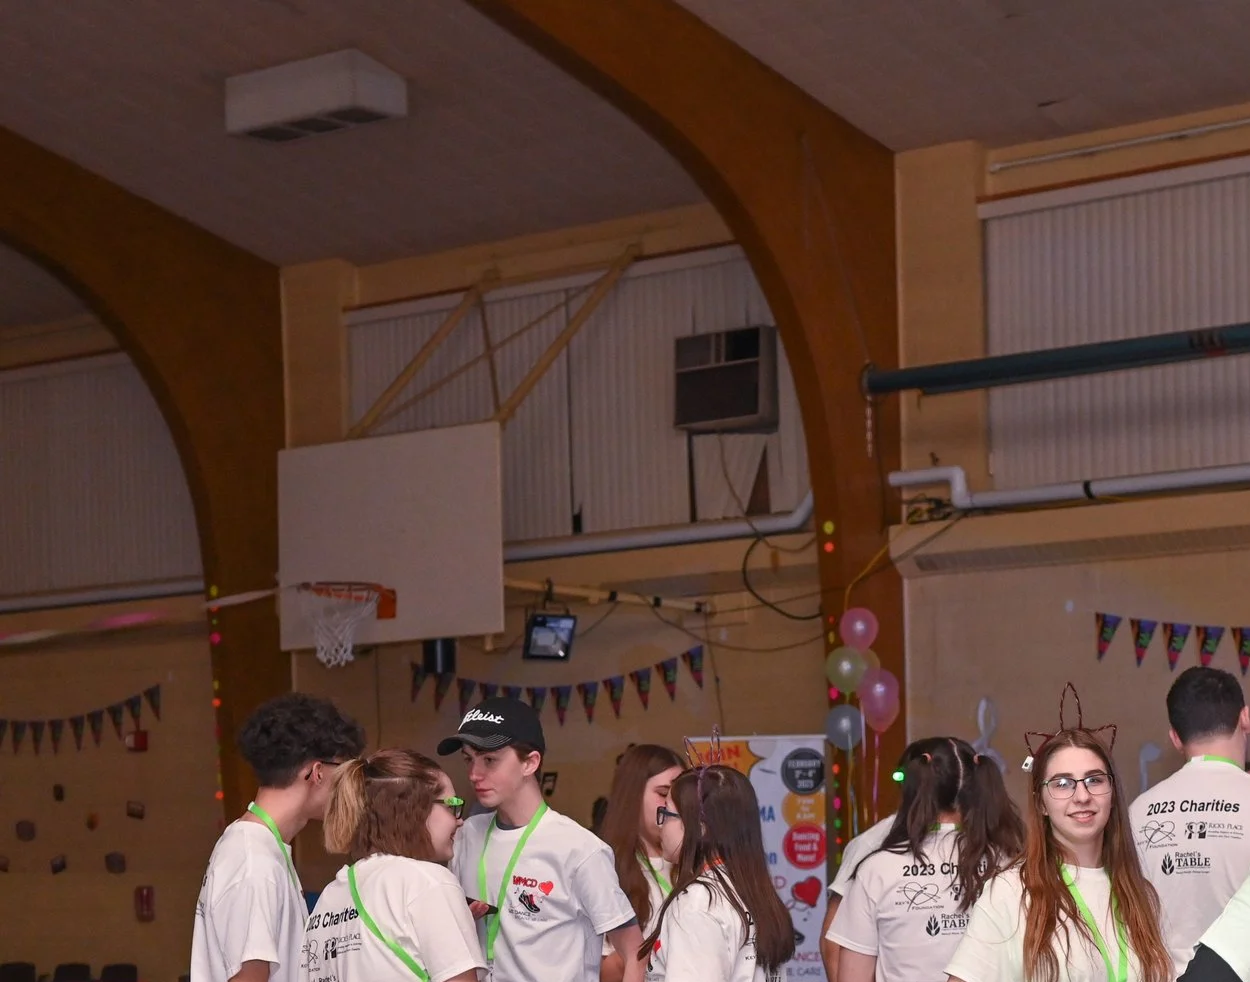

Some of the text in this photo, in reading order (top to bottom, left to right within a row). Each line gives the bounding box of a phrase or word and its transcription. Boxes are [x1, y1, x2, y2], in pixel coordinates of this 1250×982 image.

[1147, 799, 1240, 816] 2023 Charities
[1175, 857, 1211, 867] TABLE
[903, 863, 935, 877] 2023
[941, 919, 970, 929] TAB
